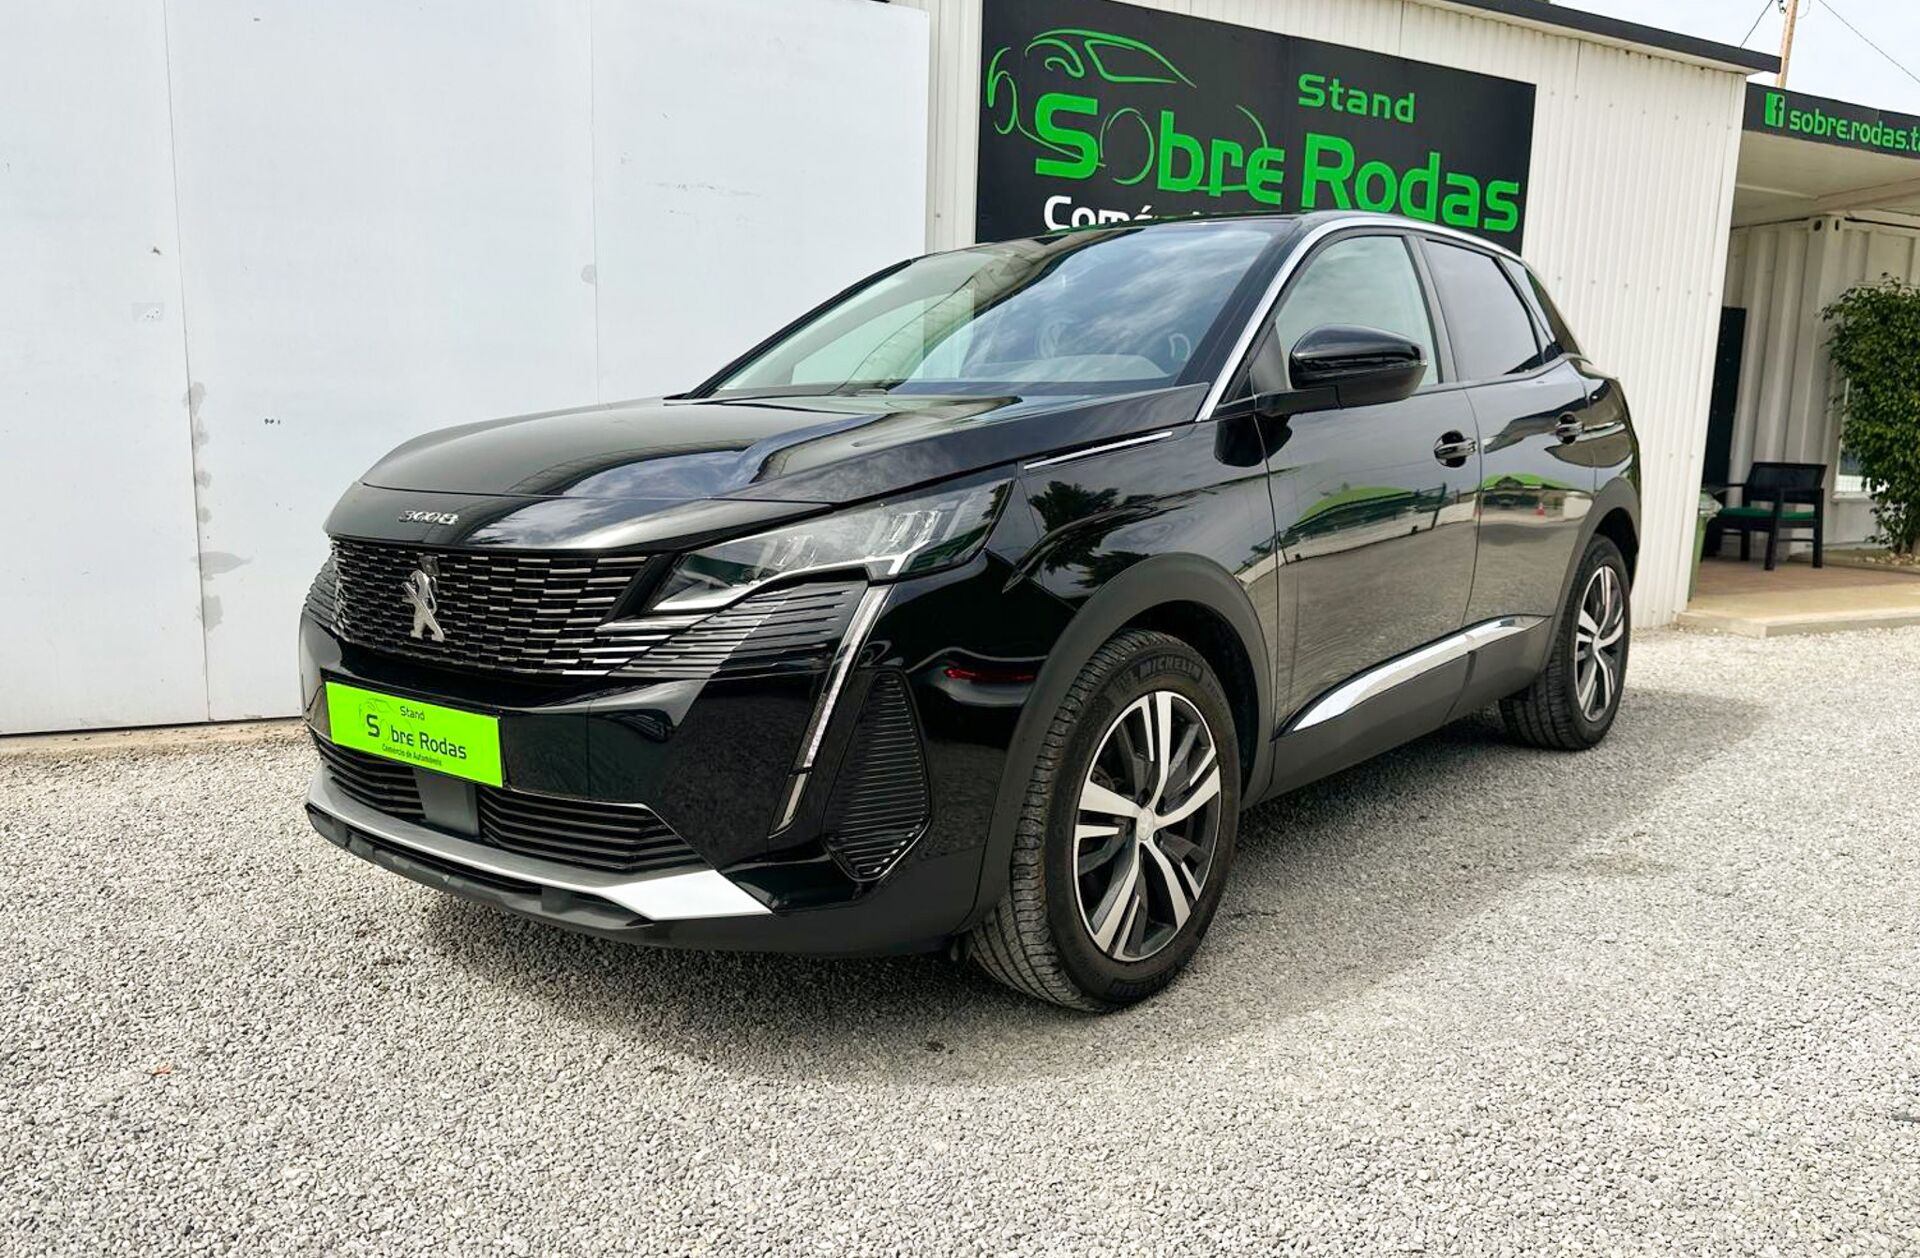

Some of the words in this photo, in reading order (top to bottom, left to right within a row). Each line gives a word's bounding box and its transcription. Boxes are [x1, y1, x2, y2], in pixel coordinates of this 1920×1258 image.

[1298, 73, 1416, 124] Stand
[1301, 132, 1520, 233] Rodas
[399, 509, 459, 525] 3008
[1139, 655, 1202, 681] MICHELIN
[400, 706, 425, 720] Stand
[419, 731, 467, 760] Rodas
